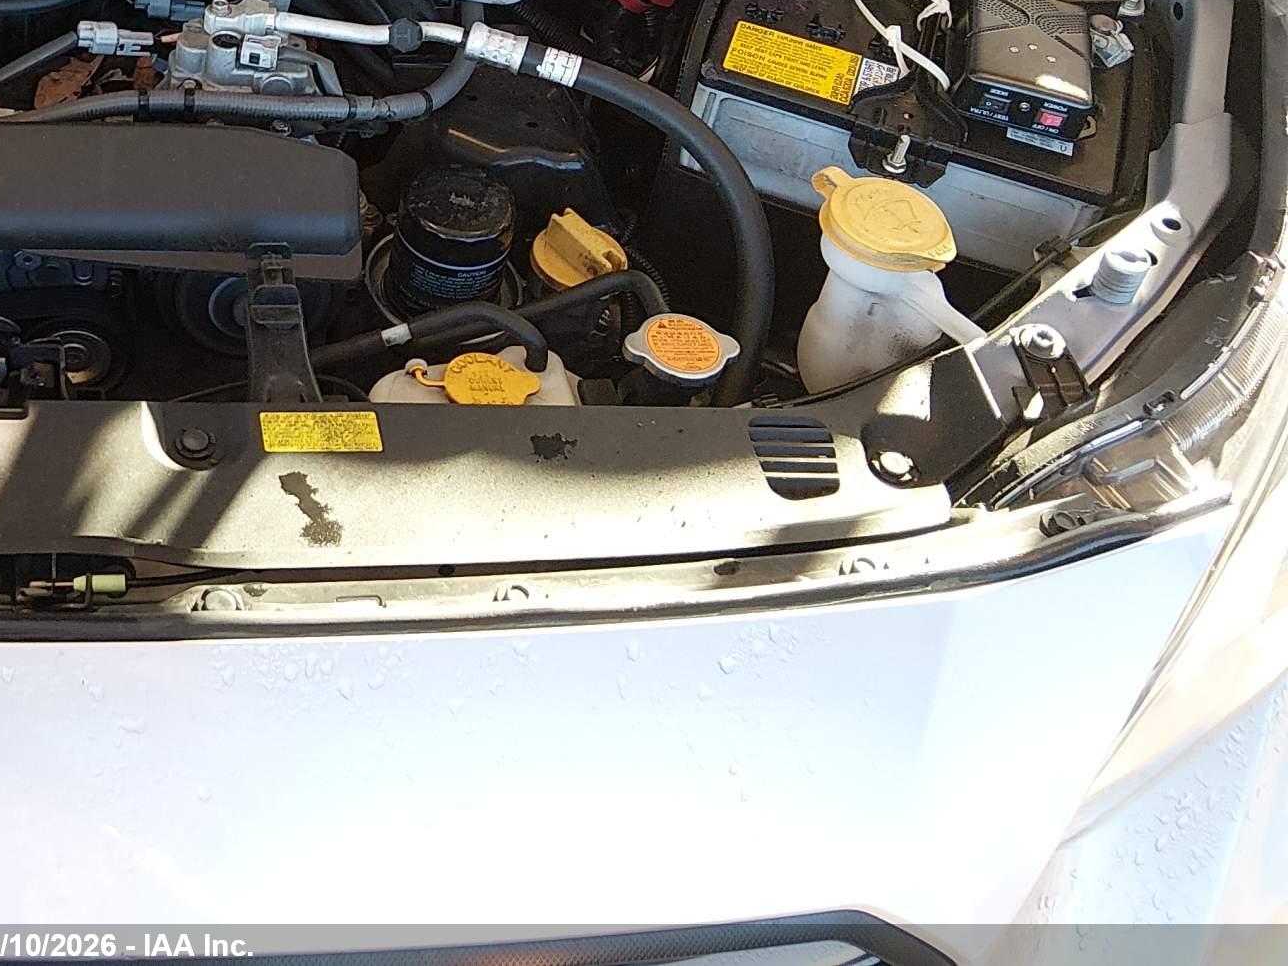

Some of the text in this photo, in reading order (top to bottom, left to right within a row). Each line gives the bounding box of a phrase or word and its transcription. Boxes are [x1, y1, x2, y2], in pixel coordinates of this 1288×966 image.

[739, 22, 774, 37] DANGER
[731, 47, 766, 61] POISON
[451, 353, 515, 374] COOLANT
